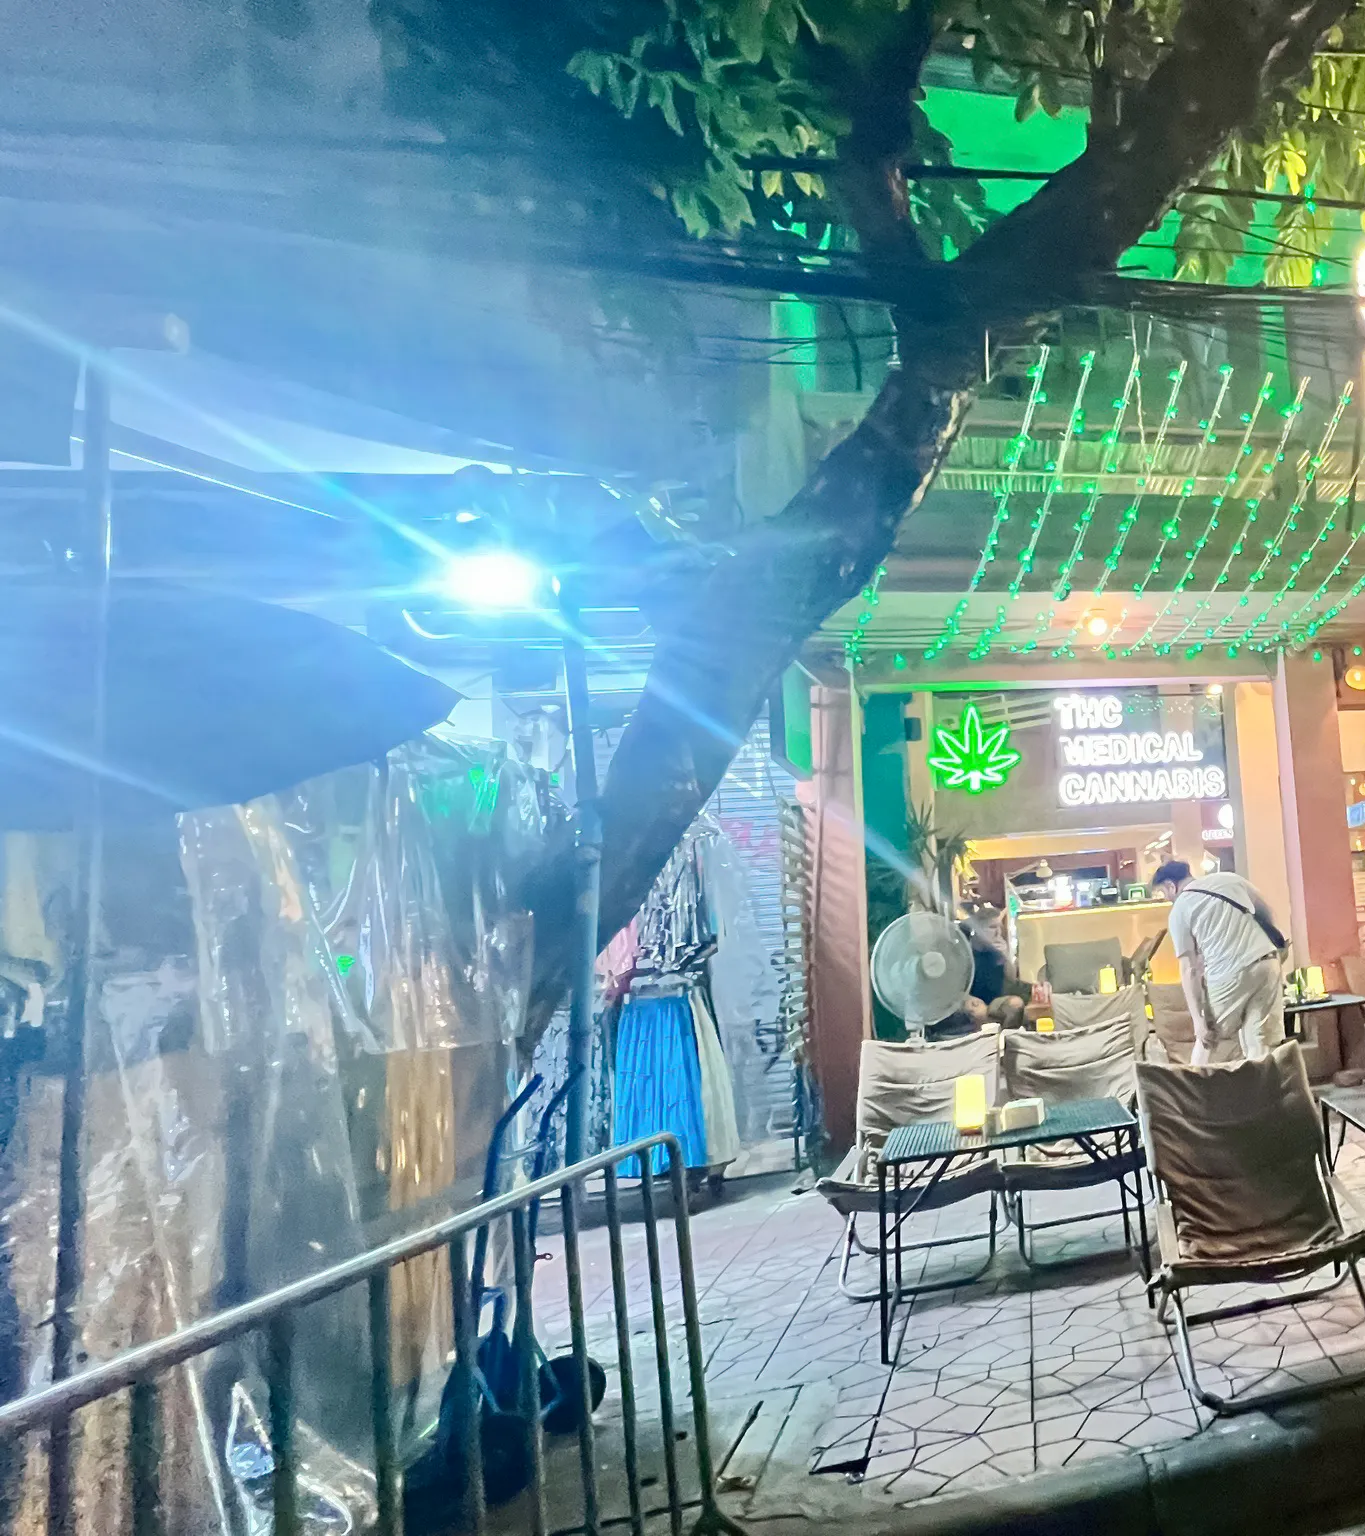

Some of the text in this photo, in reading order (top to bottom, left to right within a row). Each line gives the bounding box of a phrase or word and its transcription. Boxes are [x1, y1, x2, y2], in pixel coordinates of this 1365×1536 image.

[1054, 694, 1123, 729] THC
[1059, 731, 1203, 766] MEDICAL
[1059, 765, 1226, 805] CANNABIS
